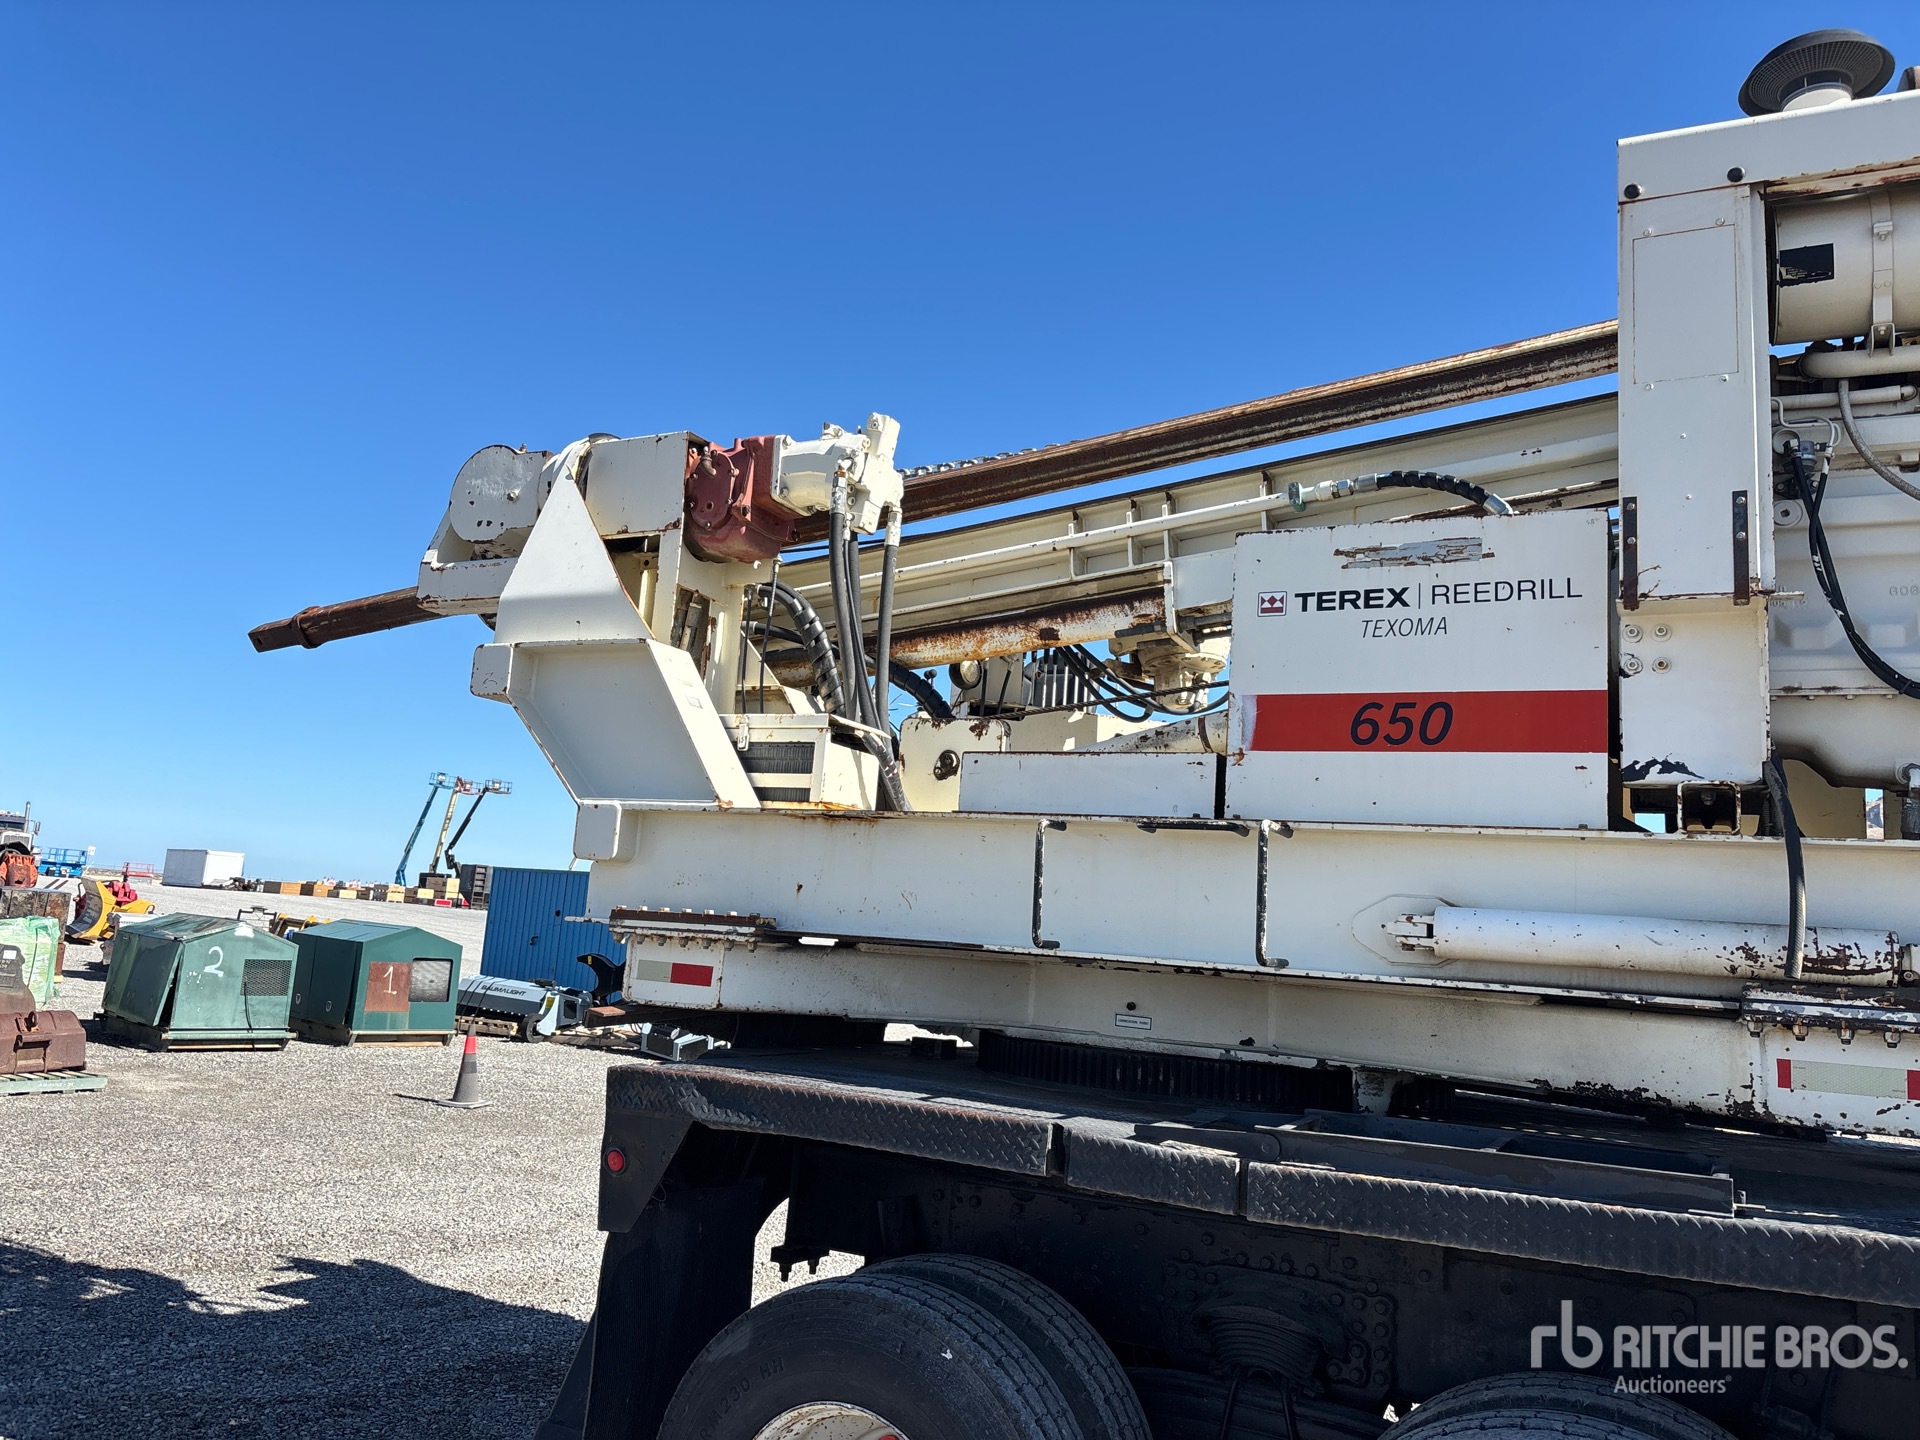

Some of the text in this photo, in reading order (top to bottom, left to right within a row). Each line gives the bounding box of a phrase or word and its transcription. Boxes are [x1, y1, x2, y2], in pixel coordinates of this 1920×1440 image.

[1294, 577, 1583, 613] TEREX REEDRILL
[1361, 616, 1448, 639] TEXOMA
[1350, 701, 1454, 746] 650
[203, 945, 225, 978] 2
[383, 965, 399, 996] 1
[759, 1356, 785, 1380] HH
